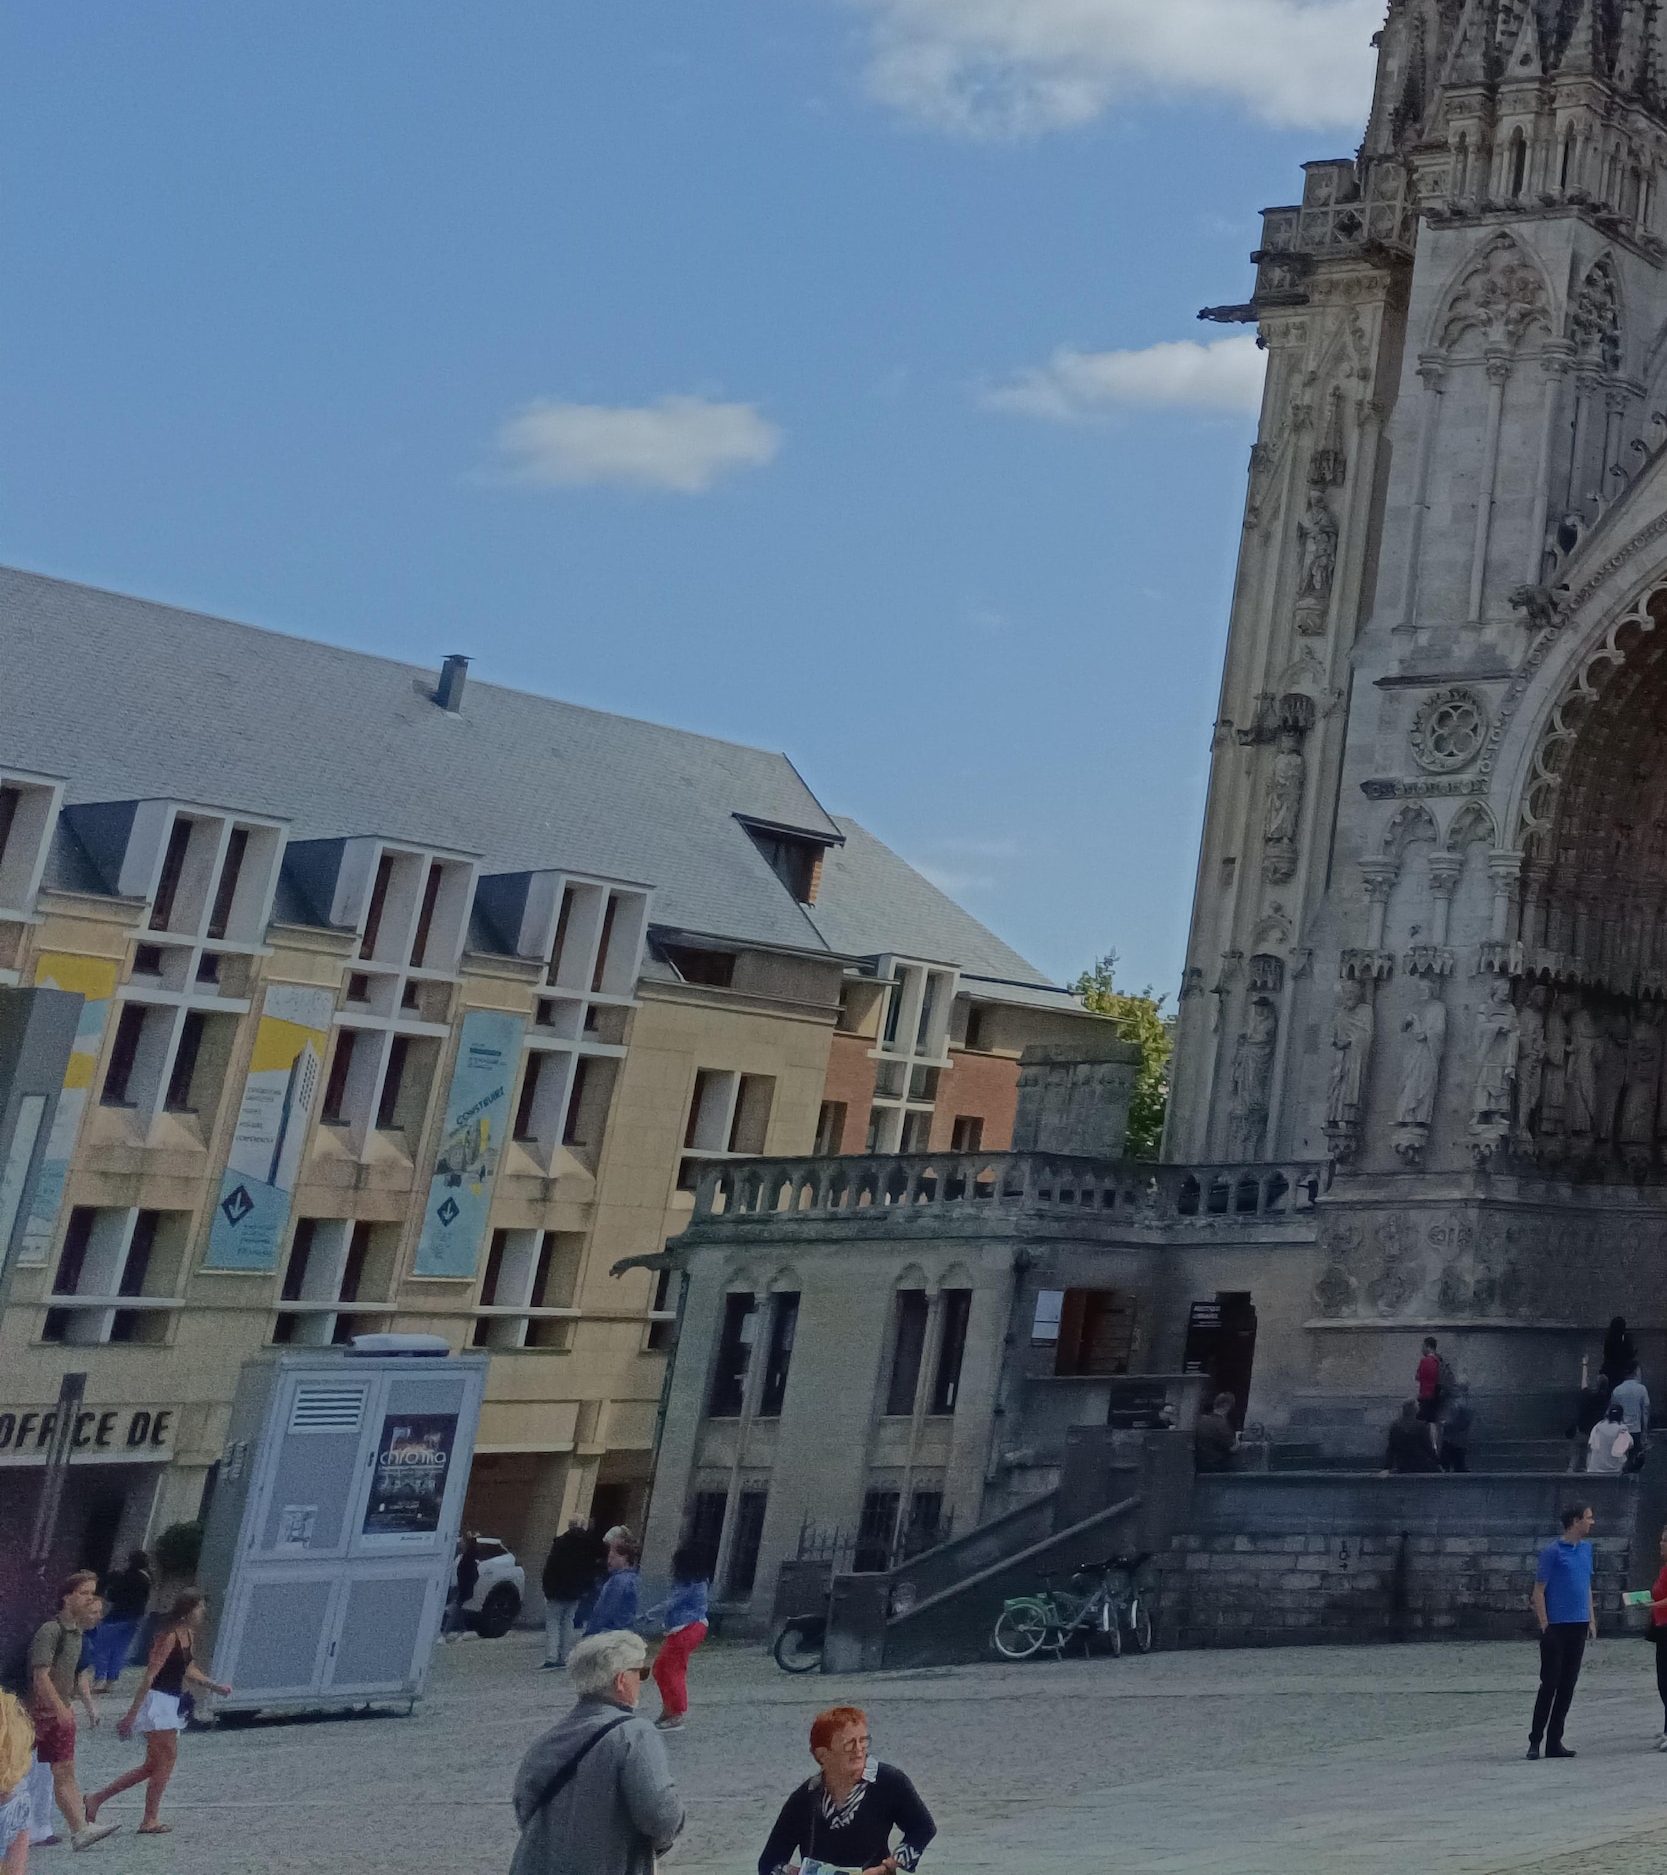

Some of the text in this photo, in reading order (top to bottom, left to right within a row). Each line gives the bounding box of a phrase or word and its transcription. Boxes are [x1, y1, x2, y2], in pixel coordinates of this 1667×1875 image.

[0, 1410, 173, 1448] OFFCE DE
[380, 1442, 447, 1465] chroma
